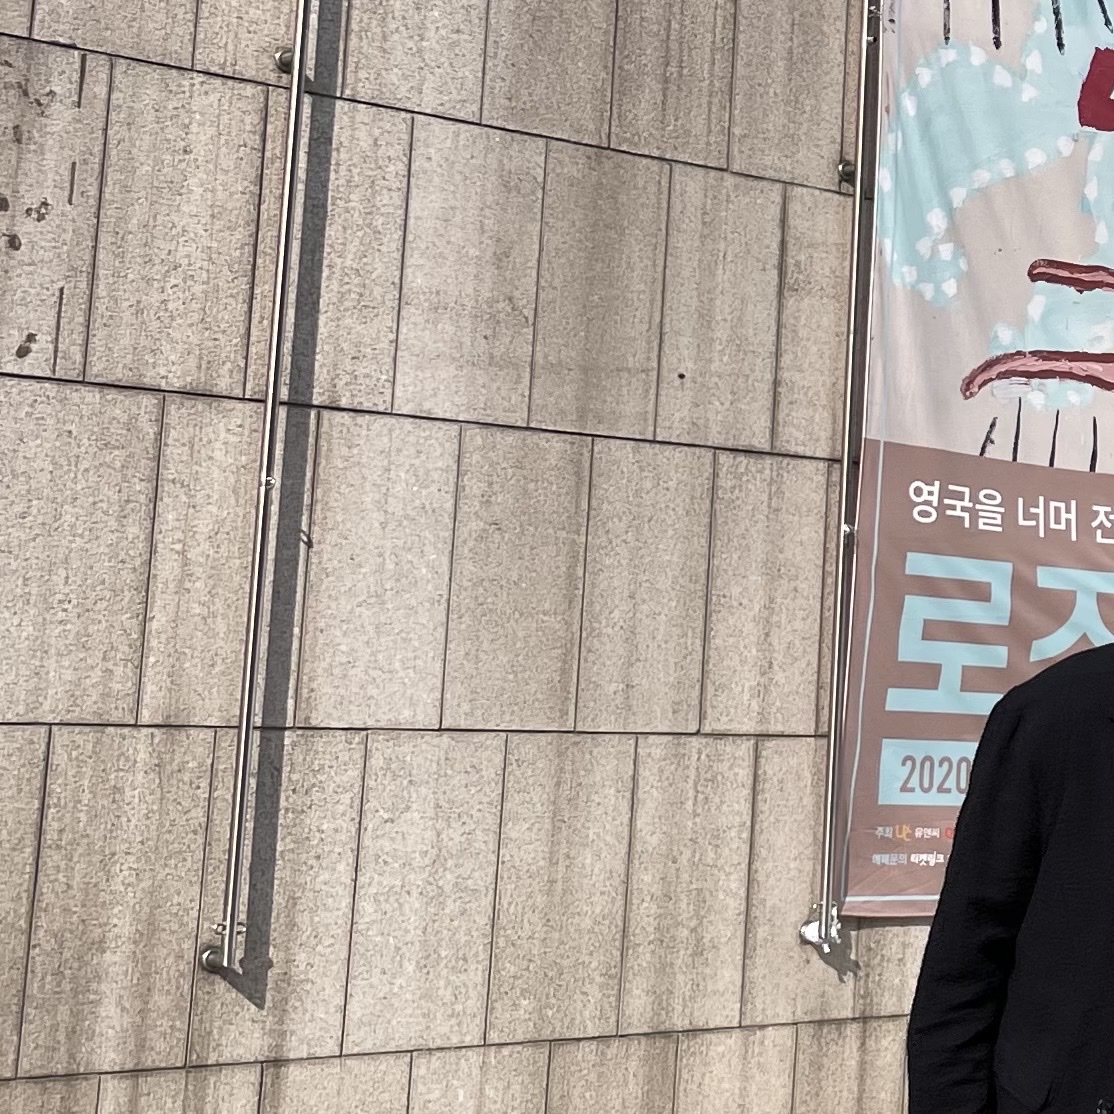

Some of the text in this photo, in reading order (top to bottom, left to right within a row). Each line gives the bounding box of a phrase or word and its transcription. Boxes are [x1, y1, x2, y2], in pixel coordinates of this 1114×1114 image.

[908, 480, 1005, 532] 영국을
[1017, 496, 1078, 541] 너머
[899, 755, 972, 794] 2020
